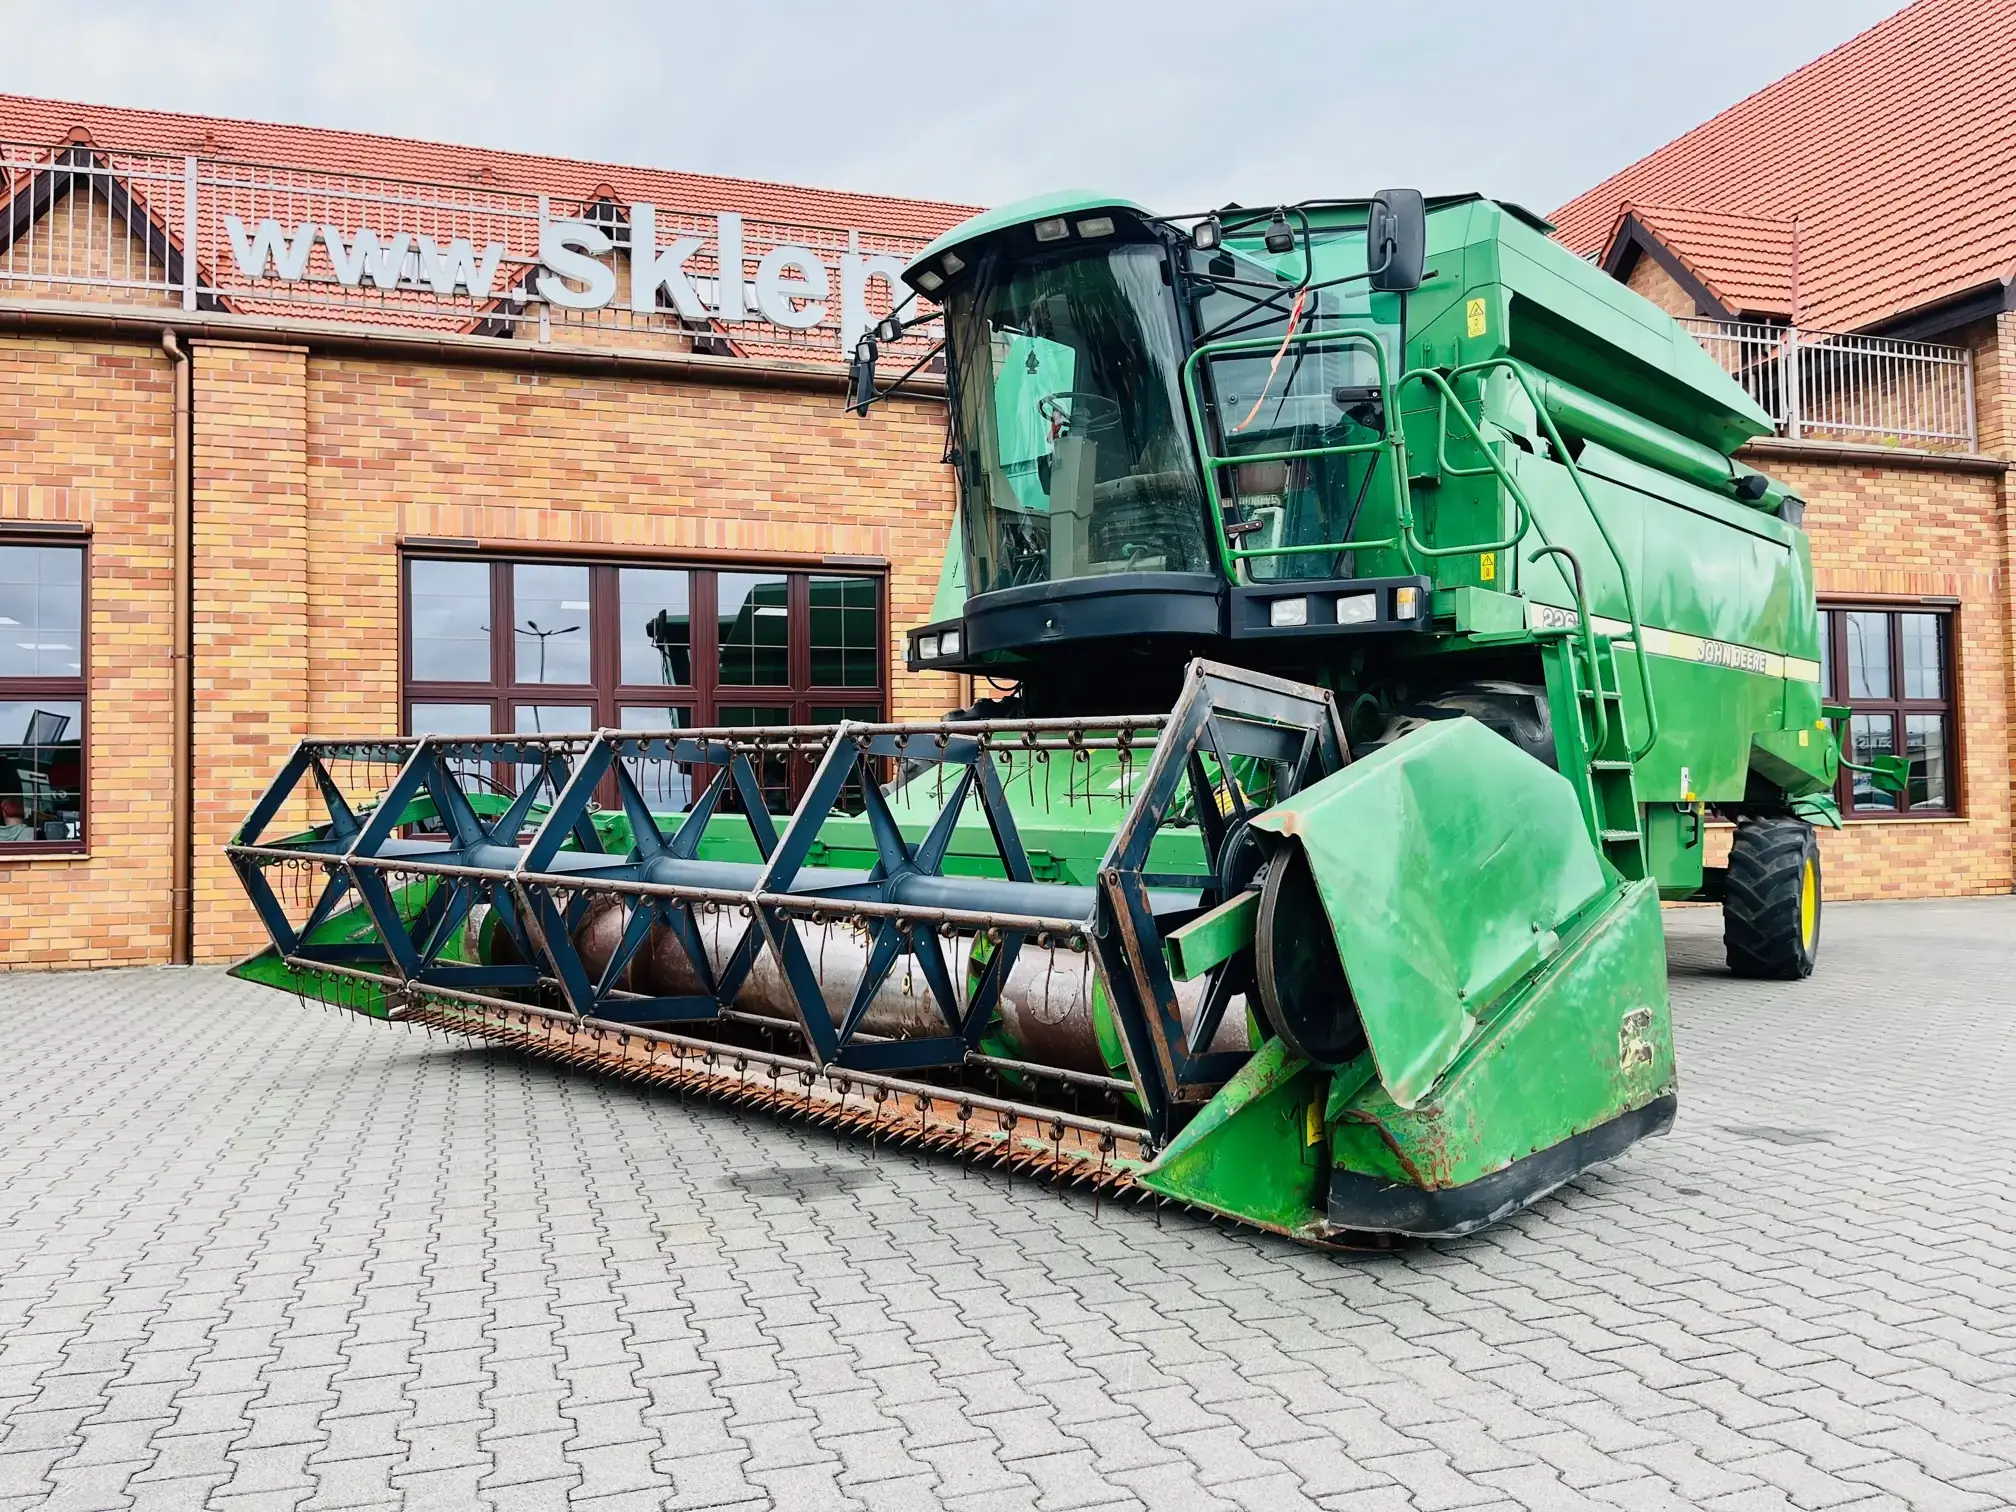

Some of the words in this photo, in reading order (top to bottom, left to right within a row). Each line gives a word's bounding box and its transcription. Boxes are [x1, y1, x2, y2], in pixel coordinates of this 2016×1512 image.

[1542, 607, 1579, 628] 226
[1697, 639, 1732, 667] JOHN
[1730, 646, 1767, 675] DEERE
